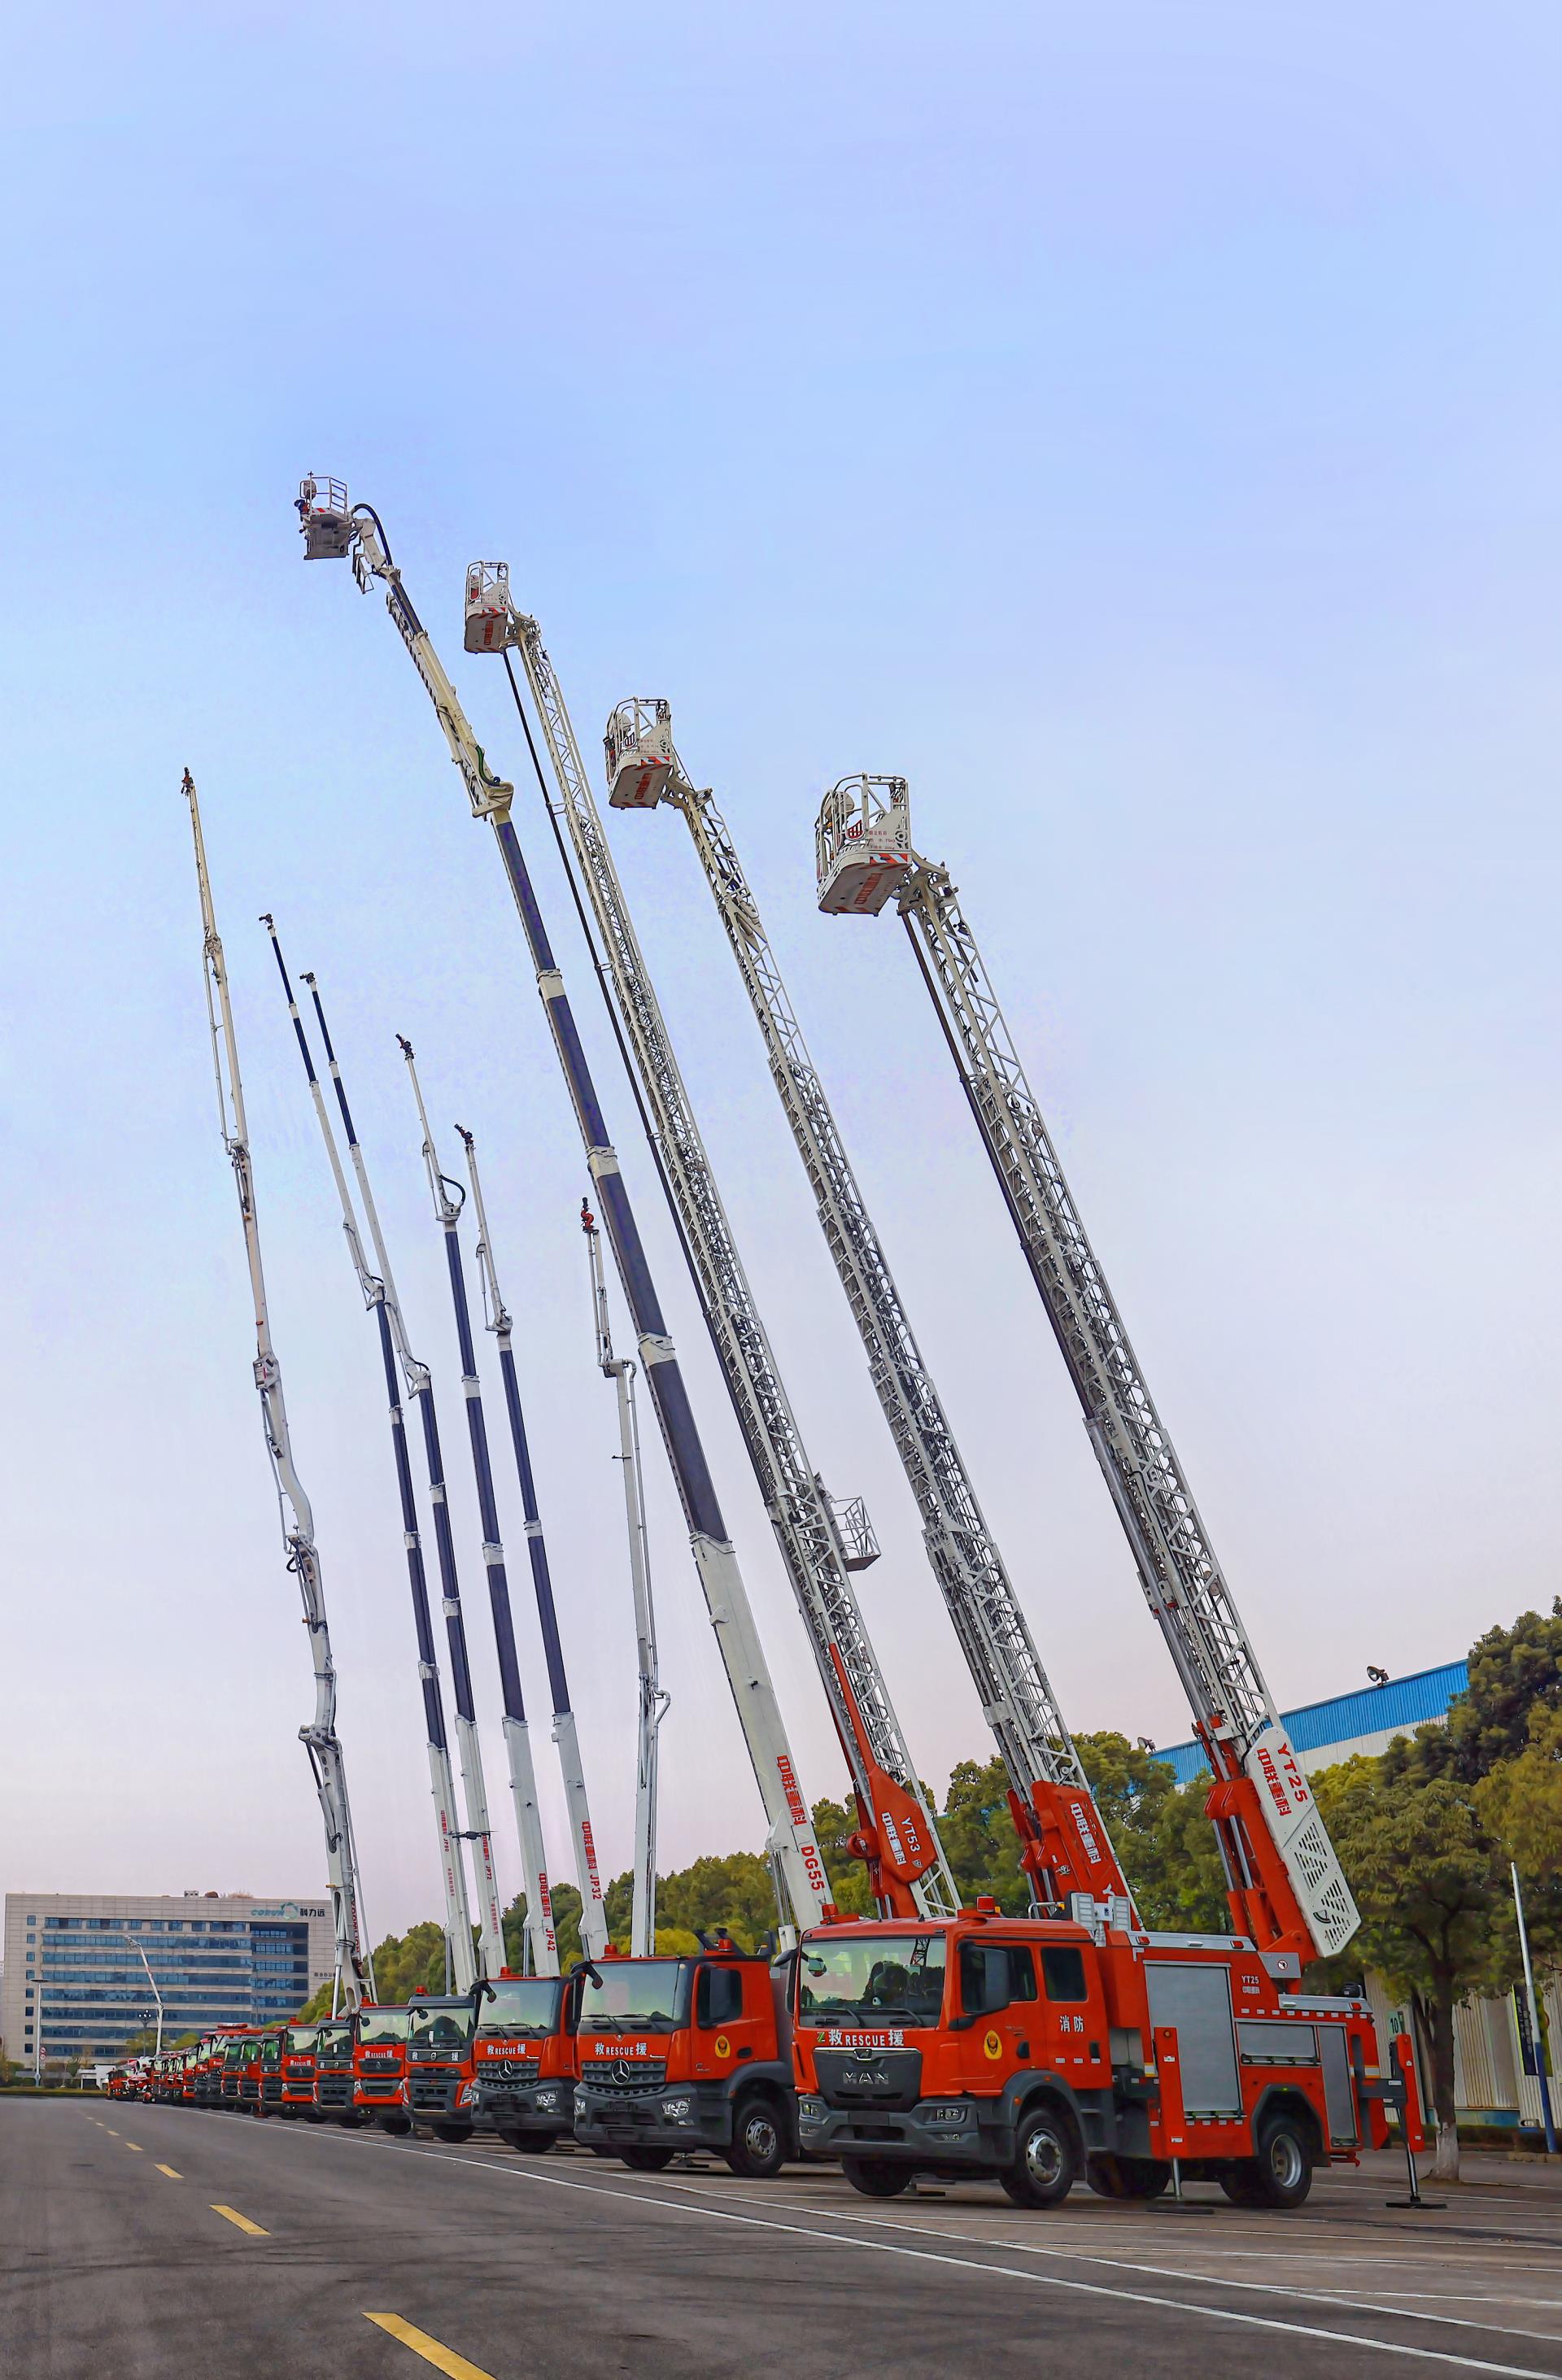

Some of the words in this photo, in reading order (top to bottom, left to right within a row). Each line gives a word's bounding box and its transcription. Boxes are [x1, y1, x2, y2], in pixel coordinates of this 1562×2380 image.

[1257, 1748, 1292, 1816] 中联重科
[1277, 1741, 1308, 1802] YT25
[776, 1755, 807, 1825] 中联重科
[801, 1846, 825, 1891] DG55
[901, 1816, 921, 1852] YT53
[1071, 1802, 1102, 1863] 中联重科
[881, 1812, 906, 1865] 中联重科
[582, 1821, 598, 1869] 中联重科
[590, 1874, 602, 1900] JP32
[299, 1908, 325, 1917] 科力远
[545, 1928, 556, 1951] JP42
[1241, 1975, 1259, 1984] YT25
[1059, 2015, 1084, 2033] 消防
[1390, 2017, 1399, 2034] 10
[595, 2042, 604, 2055] 救
[606, 2046, 634, 2056] RESCUE
[635, 2042, 647, 2056] 援
[828, 2029, 843, 2046] 救
[846, 2034, 885, 2047] RESCUE
[888, 2029, 904, 2047] 援
[843, 2073, 889, 2084] MAN
